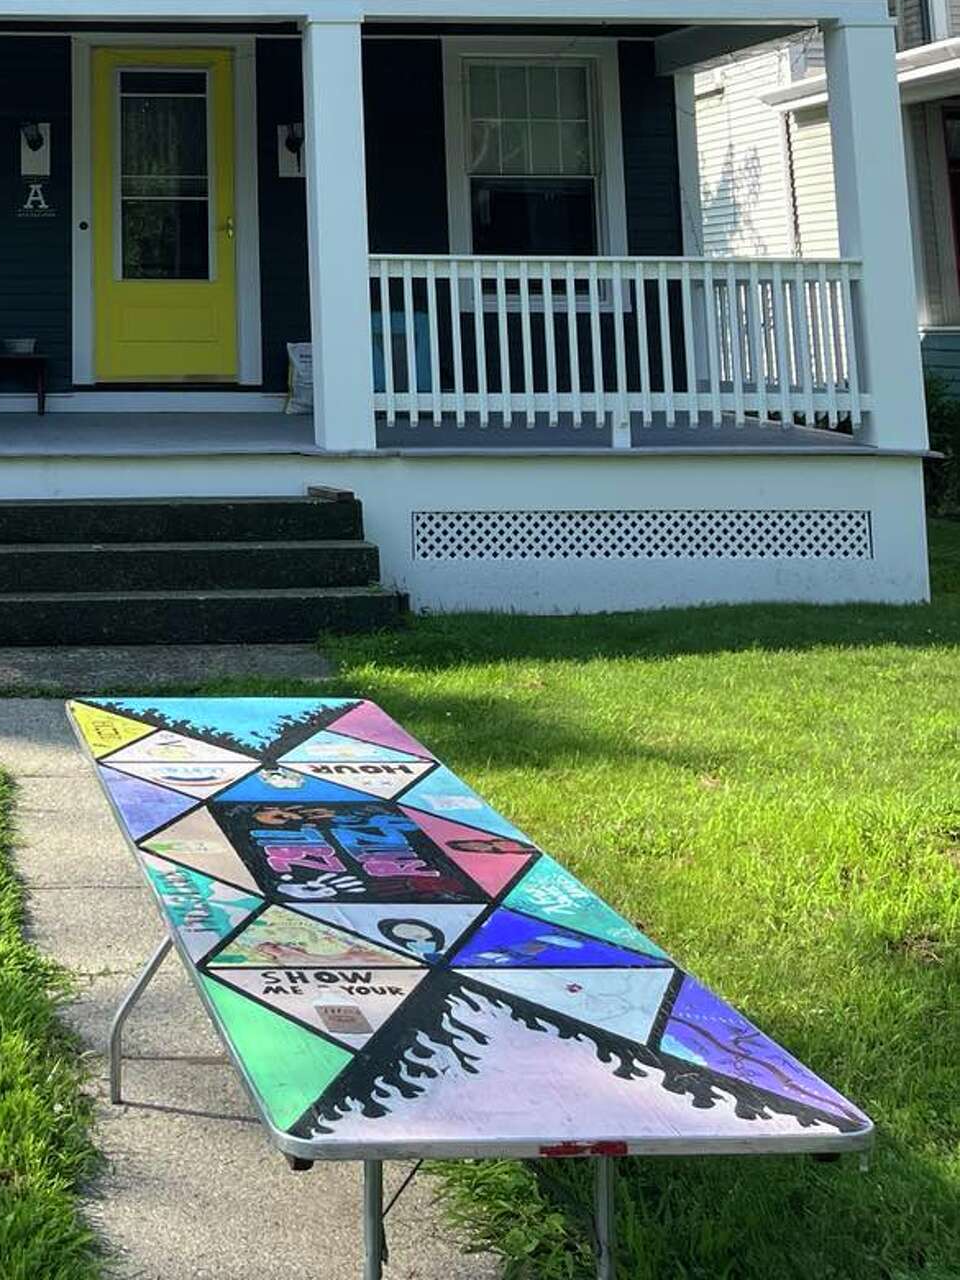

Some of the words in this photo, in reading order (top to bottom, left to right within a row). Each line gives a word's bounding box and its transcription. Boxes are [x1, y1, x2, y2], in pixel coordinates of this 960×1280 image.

[23, 184, 48, 209] A
[311, 765, 414, 774] HOUR
[261, 970, 372, 984] SHOW
[263, 985, 303, 995] ME
[341, 986, 405, 996] YOUR
